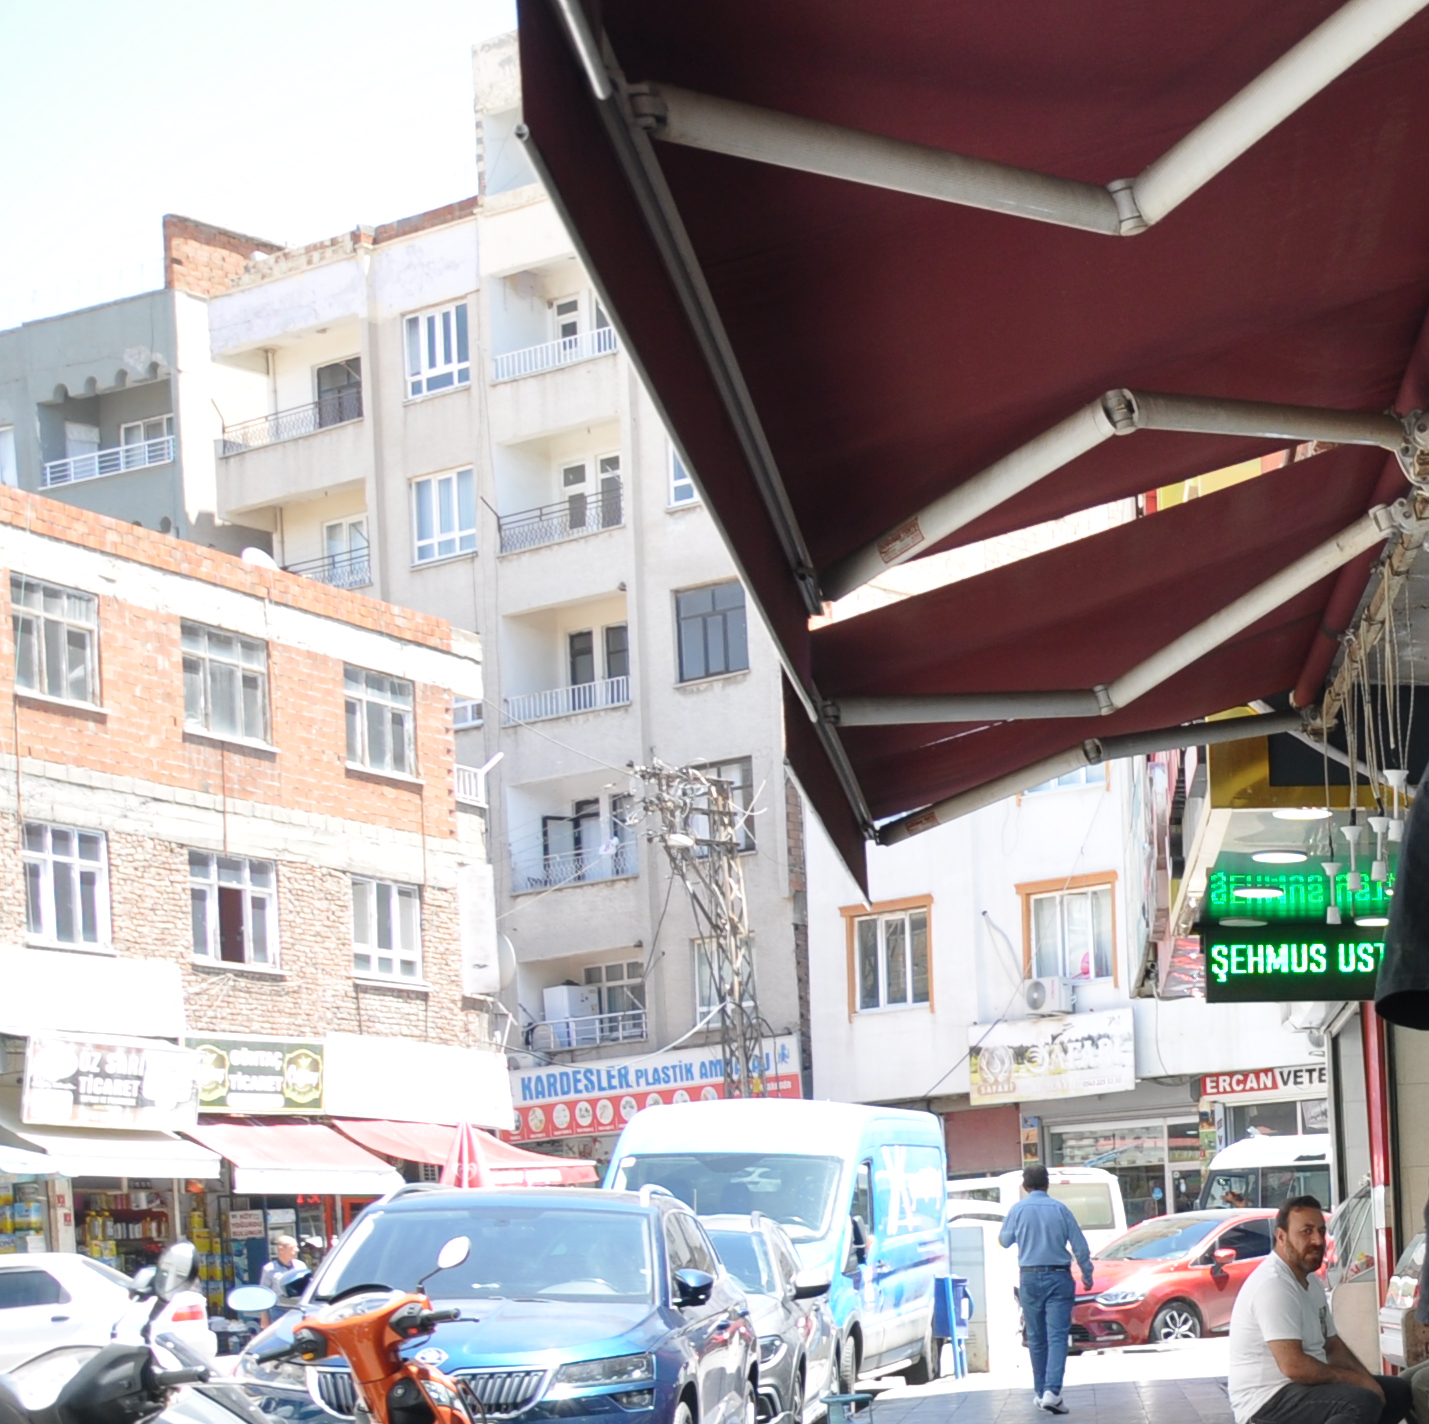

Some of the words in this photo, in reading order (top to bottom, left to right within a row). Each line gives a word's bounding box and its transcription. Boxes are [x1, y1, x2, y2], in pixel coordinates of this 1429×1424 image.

[1211, 943, 1328, 983] ŞEHMUS
[79, 1074, 142, 1098] TİCARET
[634, 1059, 695, 1088] PLASTİK
[1205, 1071, 1274, 1095] ERCAN
